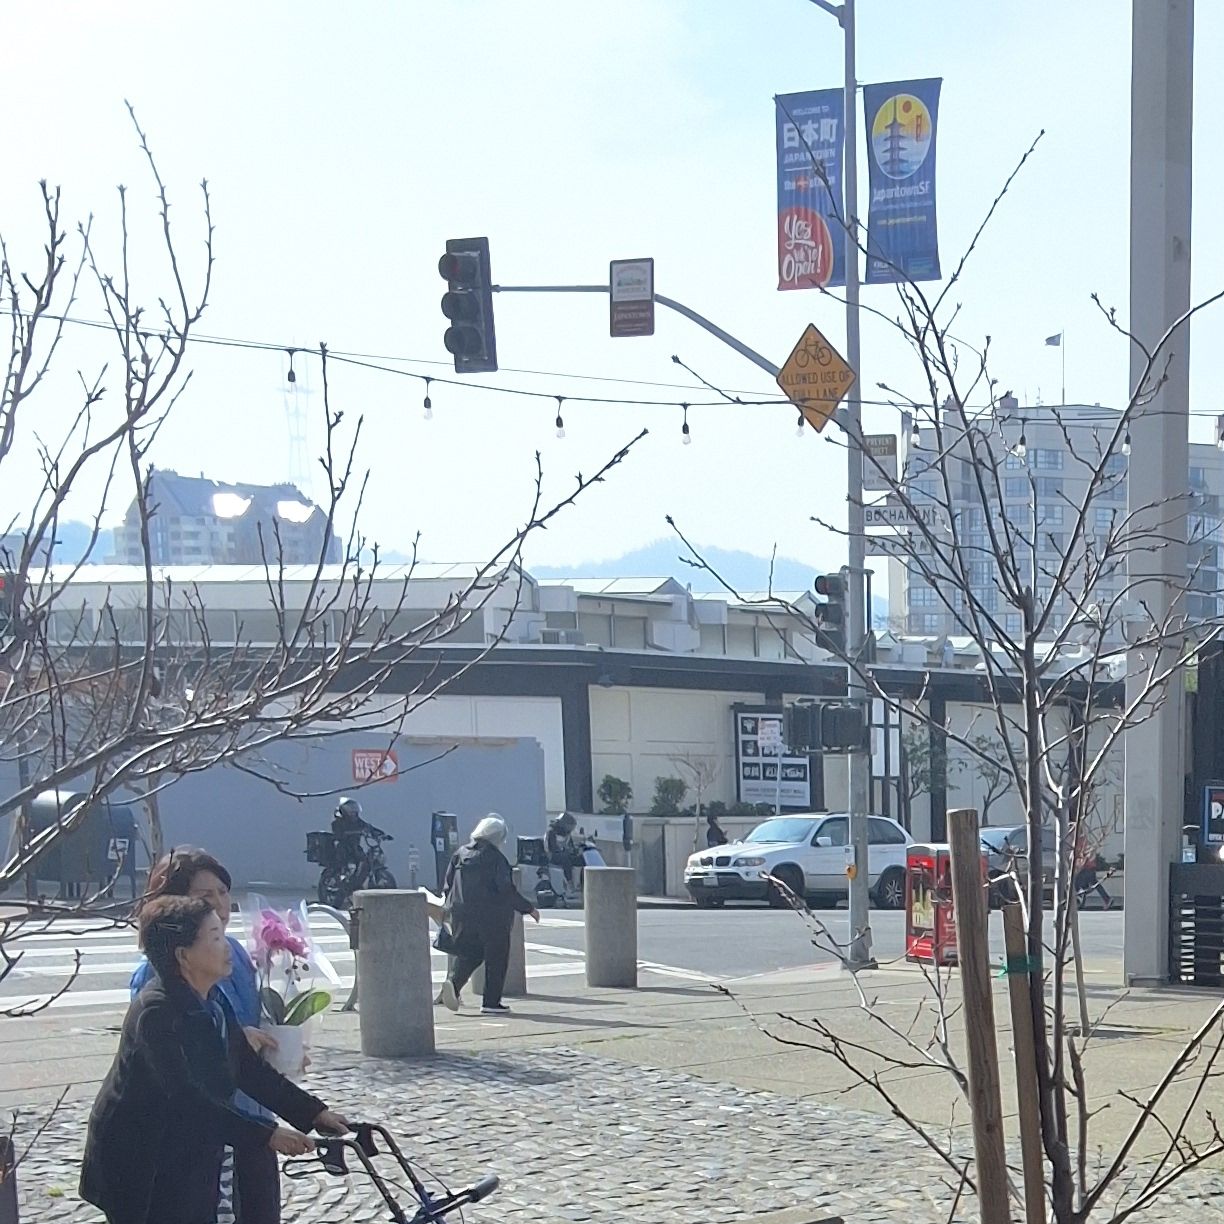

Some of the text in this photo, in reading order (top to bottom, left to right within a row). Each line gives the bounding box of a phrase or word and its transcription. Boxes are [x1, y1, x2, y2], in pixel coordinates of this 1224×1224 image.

[783, 118, 838, 149] 日本町
[784, 214, 814, 250] Yes
[782, 244, 823, 286] Open!
[820, 370, 837, 383] USE
[354, 757, 382, 769] WEST
